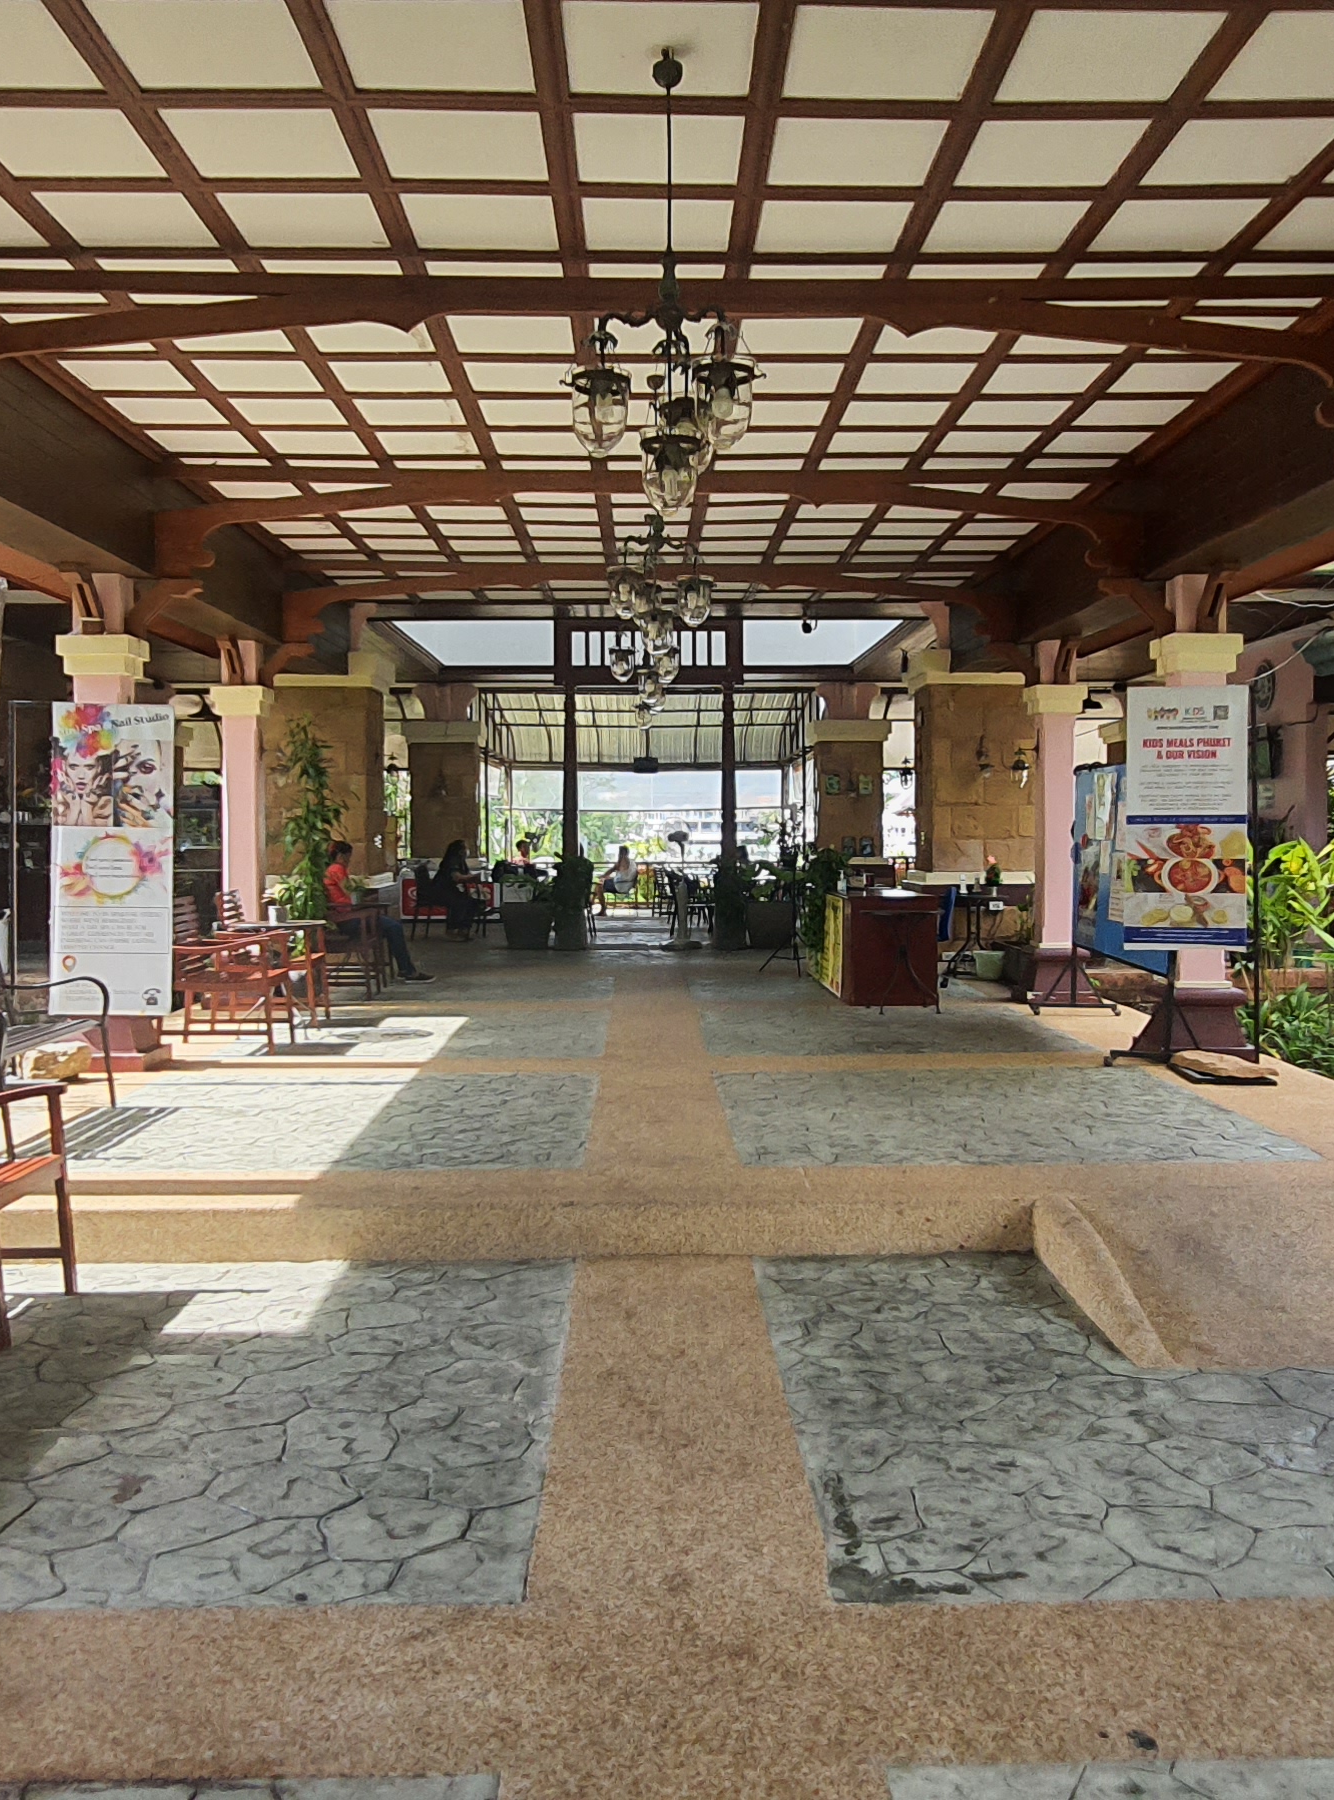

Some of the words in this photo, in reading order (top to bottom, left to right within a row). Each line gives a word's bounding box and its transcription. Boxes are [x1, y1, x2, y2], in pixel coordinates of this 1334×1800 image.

[111, 717, 132, 728] Nail
[134, 713, 170, 725] Studio
[1142, 738, 1164, 749] KIDS
[1166, 738, 1195, 748] MEALS
[1197, 737, 1232, 748] PHUKET
[1165, 750, 1185, 760] OUR
[1187, 749, 1217, 759] VISION
